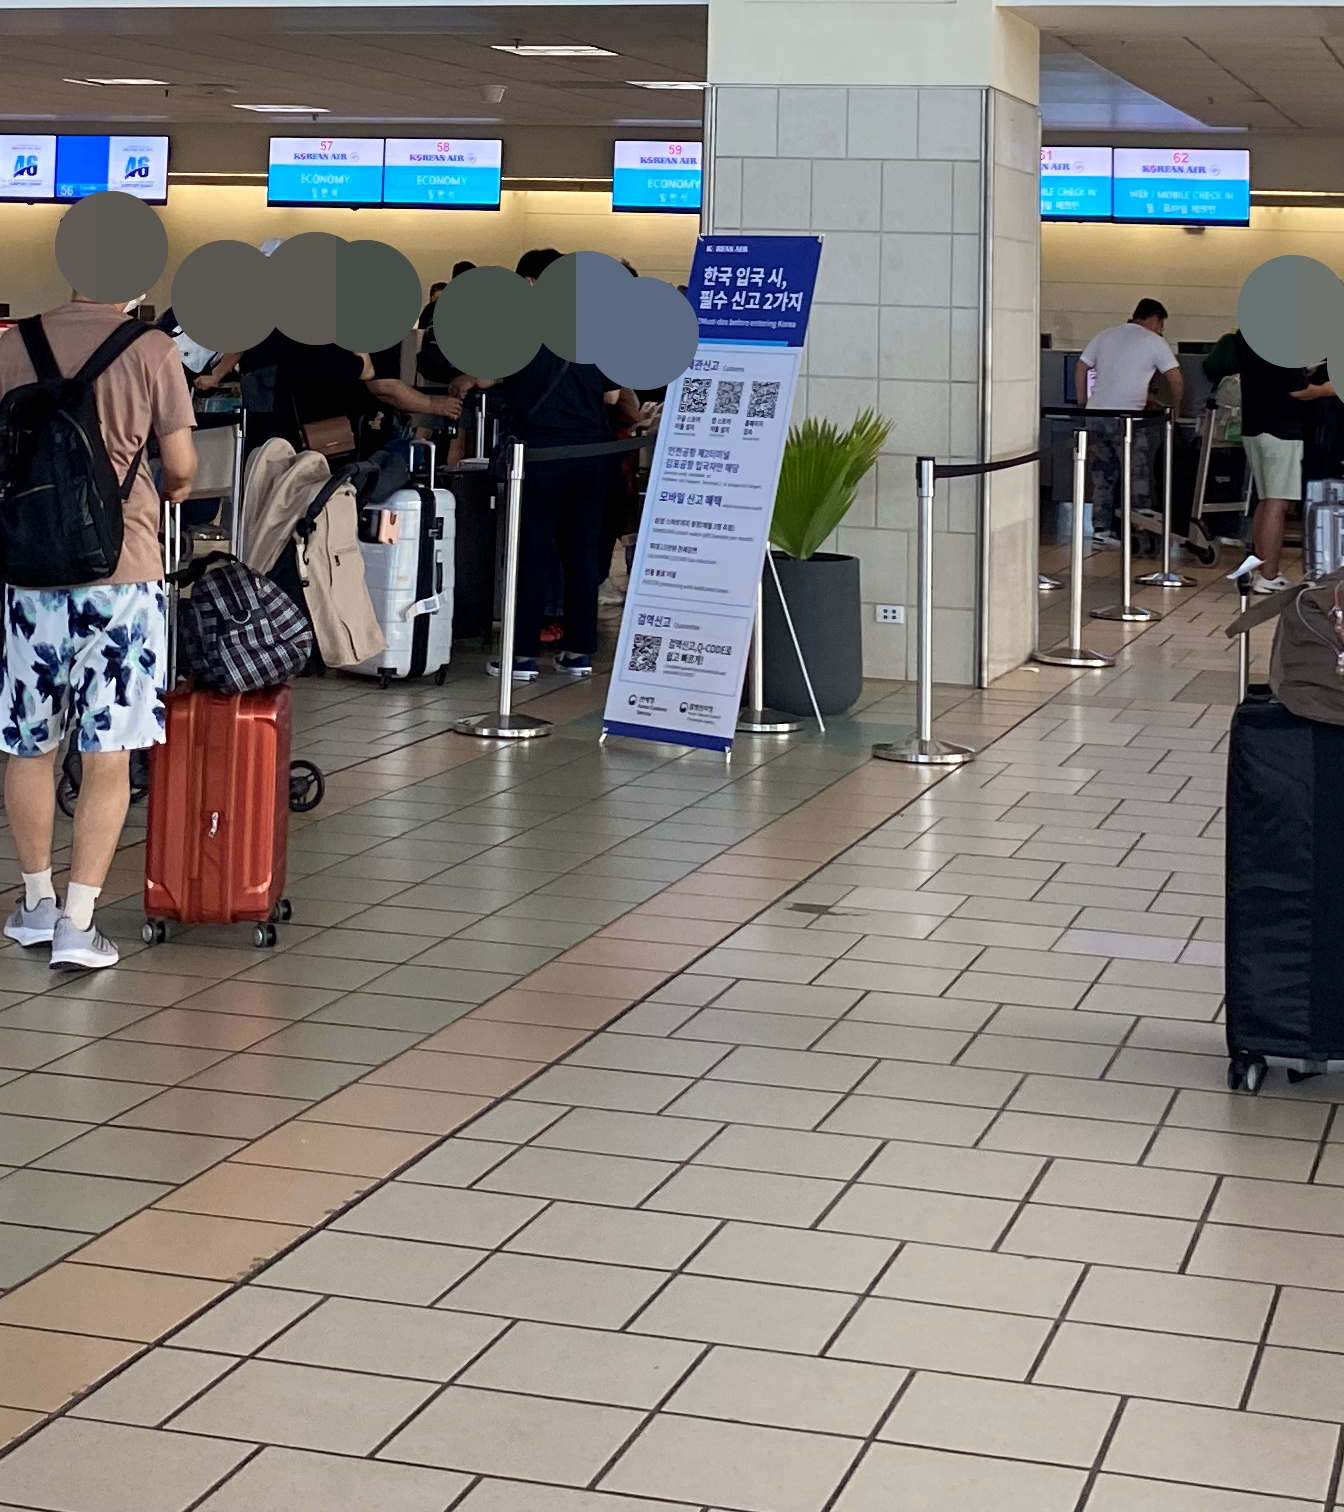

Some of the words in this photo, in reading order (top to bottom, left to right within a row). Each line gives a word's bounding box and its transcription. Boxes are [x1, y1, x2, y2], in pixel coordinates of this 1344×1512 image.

[320, 141, 333, 151] 57
[436, 142, 450, 152] 58
[668, 144, 682, 155] 59
[409, 154, 445, 162] KOREAN
[446, 154, 465, 162] AIR
[640, 156, 678, 165] KOREAN
[679, 157, 697, 165] AIR
[1173, 152, 1189, 164] 62
[1051, 163, 1070, 171] AIR
[1142, 164, 1186, 174] KOREAN
[1186, 165, 1207, 175] AIR
[300, 173, 350, 185] ECONOMY
[416, 175, 468, 186] ECONOMY
[647, 178, 701, 190] ECONOMY
[60, 184, 74, 197] 56
[703, 266, 733, 287] 한국
[735, 266, 766, 287] 입국
[767, 267, 788, 290] 시,
[699, 289, 729, 310] 필수
[731, 290, 761, 310] 신고
[762, 291, 804, 312] 2가지
[659, 490, 686, 505] 모바일
[686, 493, 704, 506] 신고
[637, 613, 672, 628] 검역신고
